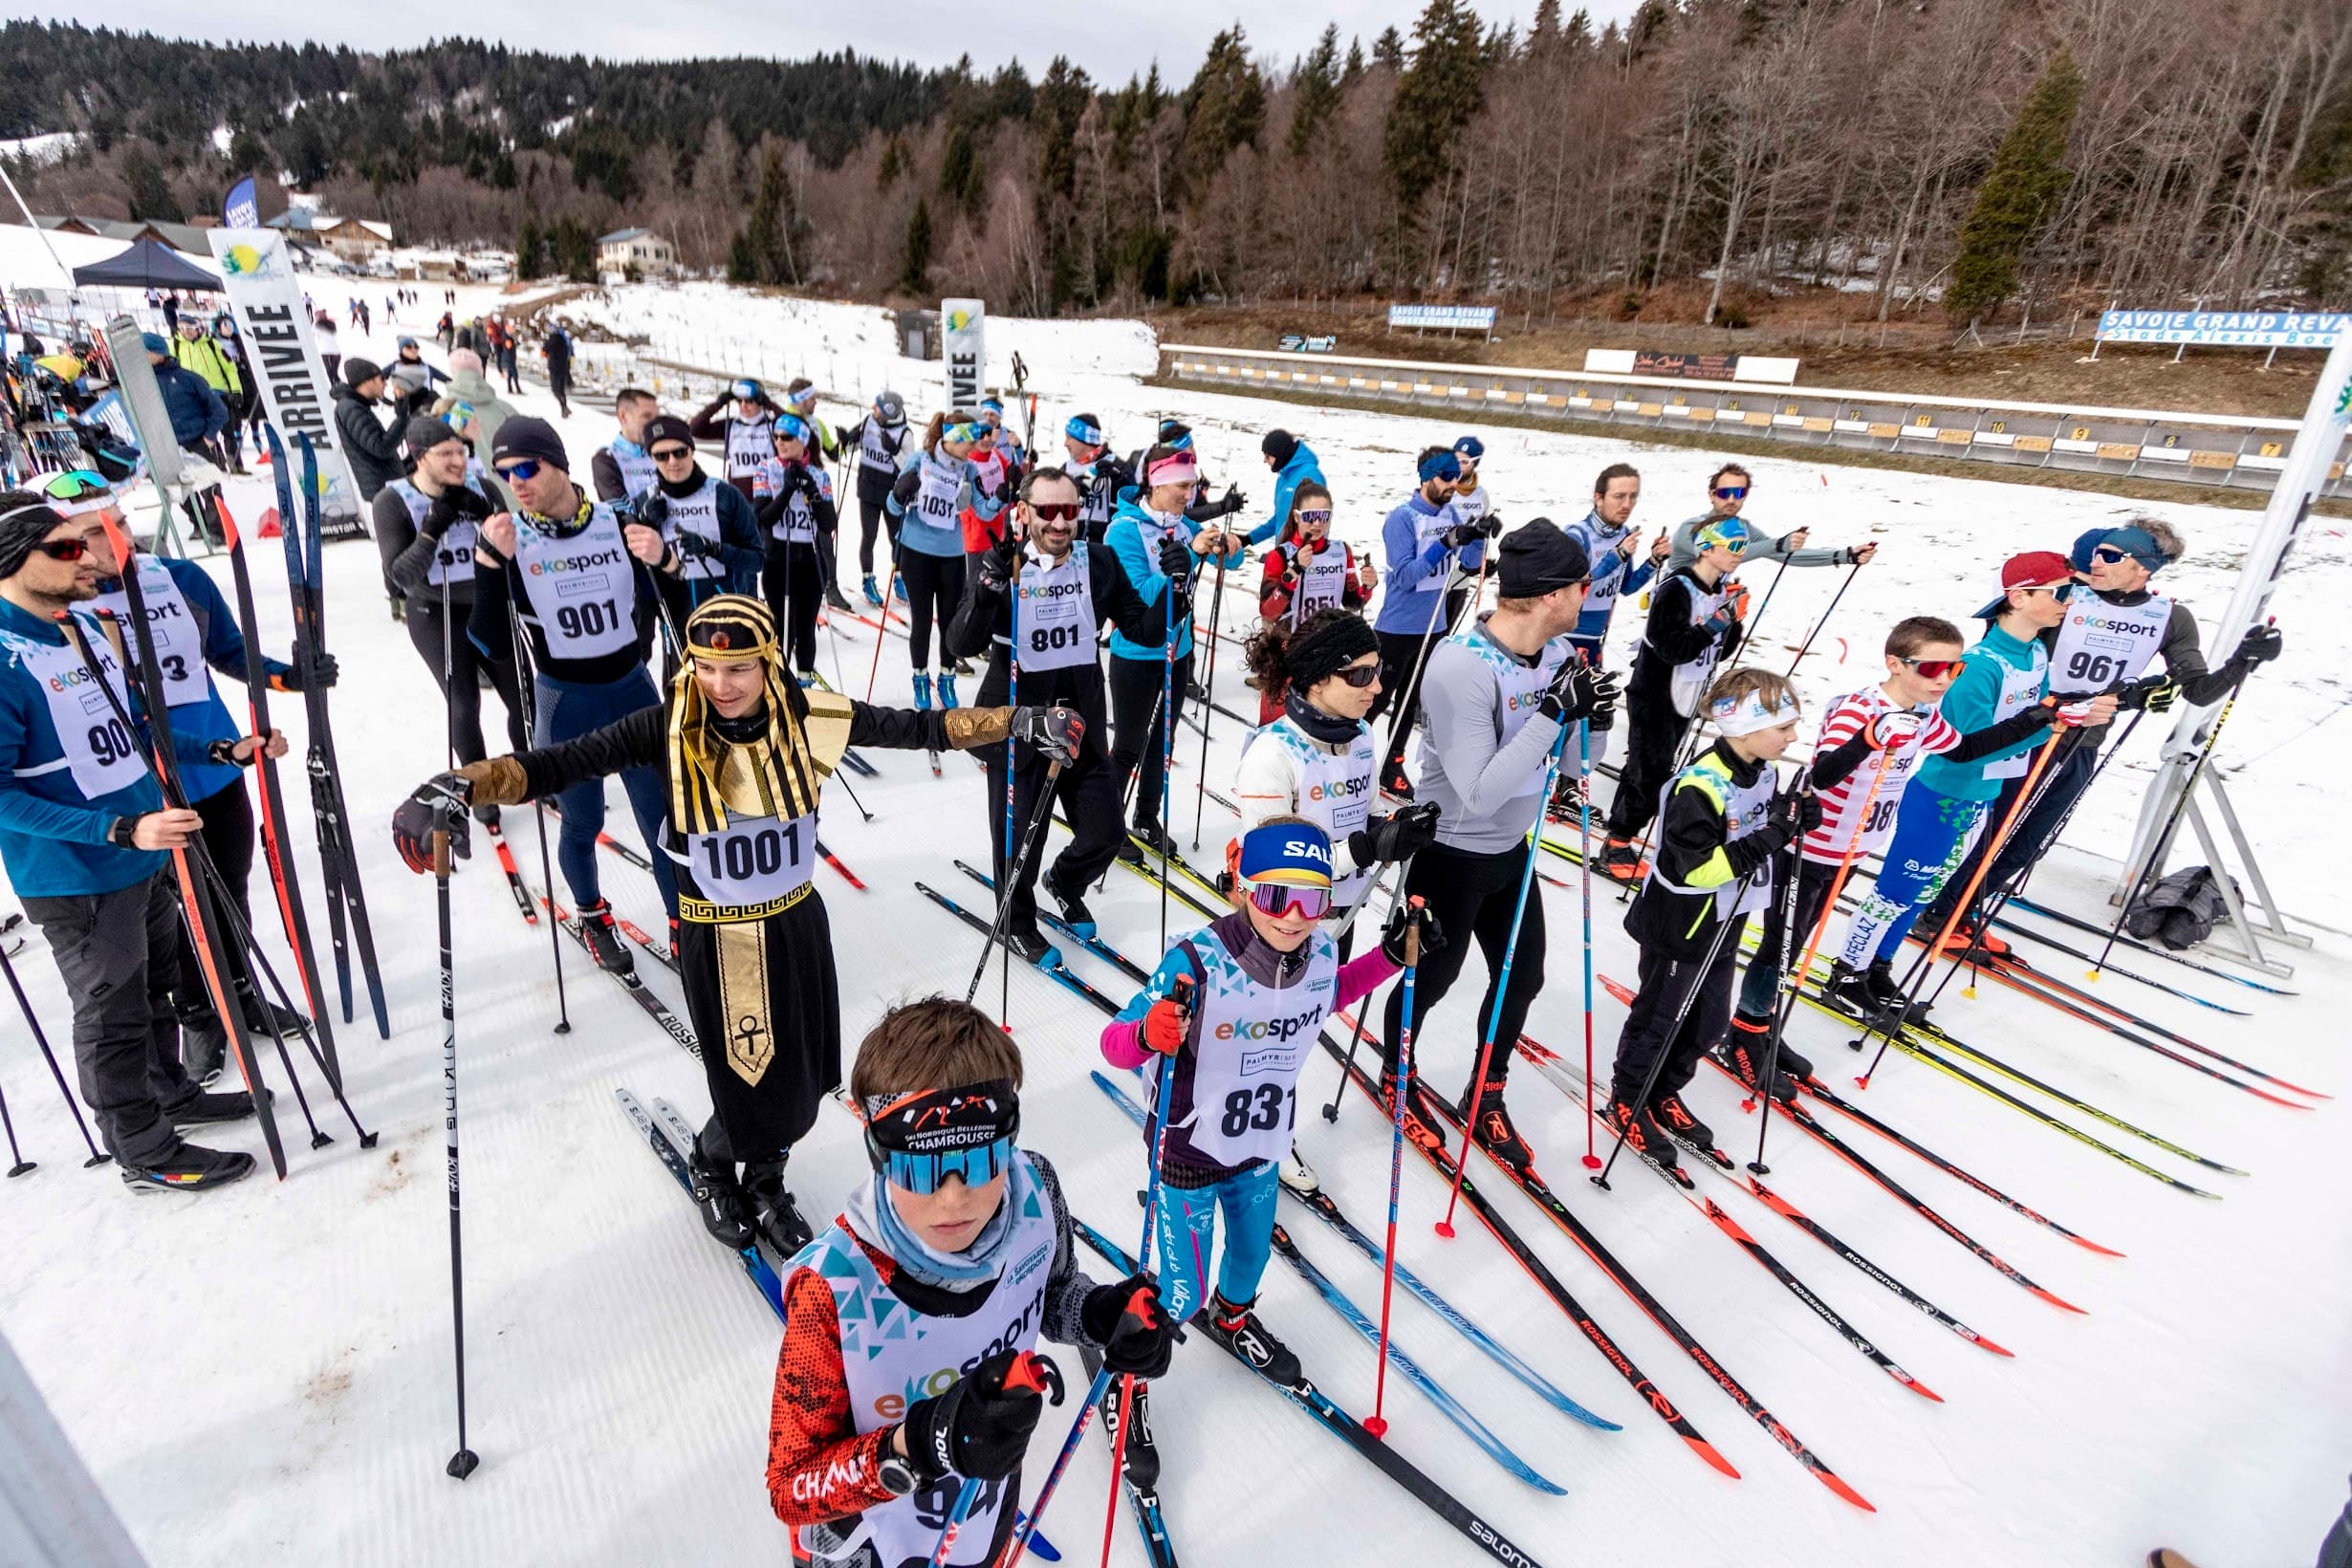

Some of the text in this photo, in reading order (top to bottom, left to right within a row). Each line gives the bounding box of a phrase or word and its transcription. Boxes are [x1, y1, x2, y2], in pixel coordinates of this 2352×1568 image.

[2106, 313, 2188, 328] SAVOIE
[2192, 314, 2276, 330] GRAND
[2113, 327, 2181, 340] Stade
[2191, 329, 2273, 343] Alexis
[244, 303, 334, 450] ARRIVÉE
[1992, 422, 2005, 433] 10
[2076, 428, 2084, 440] 9
[2166, 436, 2176, 447] 8
[2267, 445, 2277, 456] 7
[530, 547, 622, 577] ekosport
[1018, 580, 1083, 600] ekosport
[556, 599, 620, 639] 901
[2073, 614, 2157, 638] ekosport
[1031, 623, 1078, 652] 801
[2067, 651, 2129, 683] 961
[88, 718, 137, 767] 90
[701, 822, 799, 881] 1001
[1215, 1003, 1322, 1042] ekosport
[444, 1033, 457, 1132] VIKING
[908, 1131, 995, 1150] CHAMROUSSE
[917, 1128, 955, 1139] NORDIQUE
[1917, 1206, 1970, 1243] ROSSIGNOL
[1845, 1251, 1904, 1295] ROSSIGNOL
[1789, 1282, 1843, 1332] ROSSIGNOL
[1580, 1319, 1634, 1377] ROSSIGNOL
[1690, 1345, 1750, 1405] ROSSIGNOL
